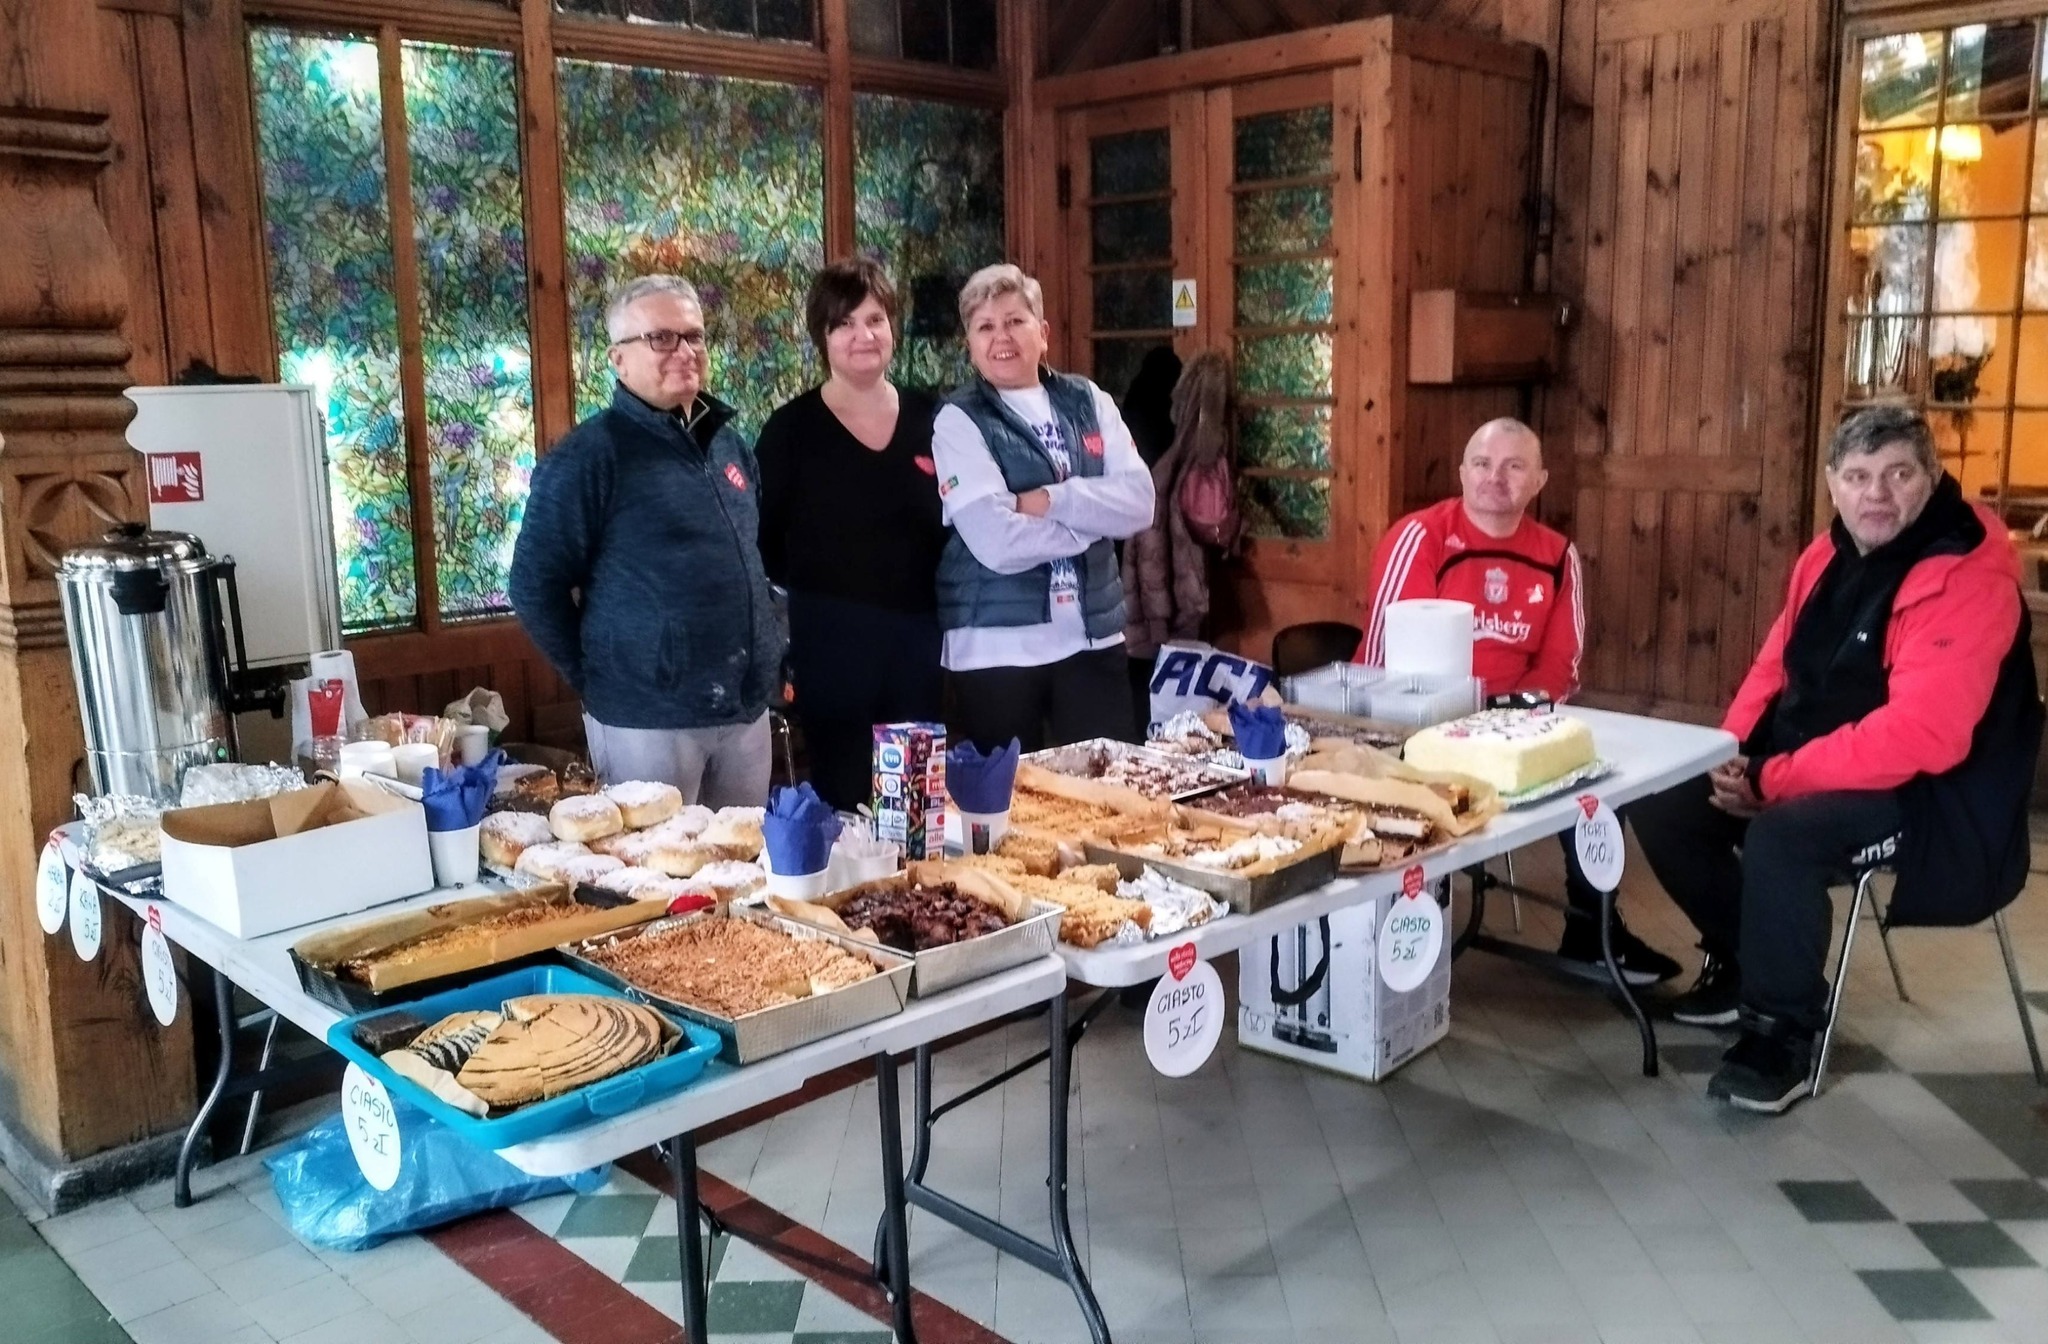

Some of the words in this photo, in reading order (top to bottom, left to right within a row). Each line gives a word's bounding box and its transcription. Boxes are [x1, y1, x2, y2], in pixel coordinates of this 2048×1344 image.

[1473, 610, 1531, 642] rlsberg
[884, 753, 899, 764] tvn
[1585, 842, 1606, 863] 100
[1391, 915, 1431, 934] CIASTO
[1391, 940, 1401, 962] 5
[1157, 983, 1205, 1014] CIASTO
[1168, 1017, 1181, 1049] 5
[358, 1116, 369, 1142] 5
